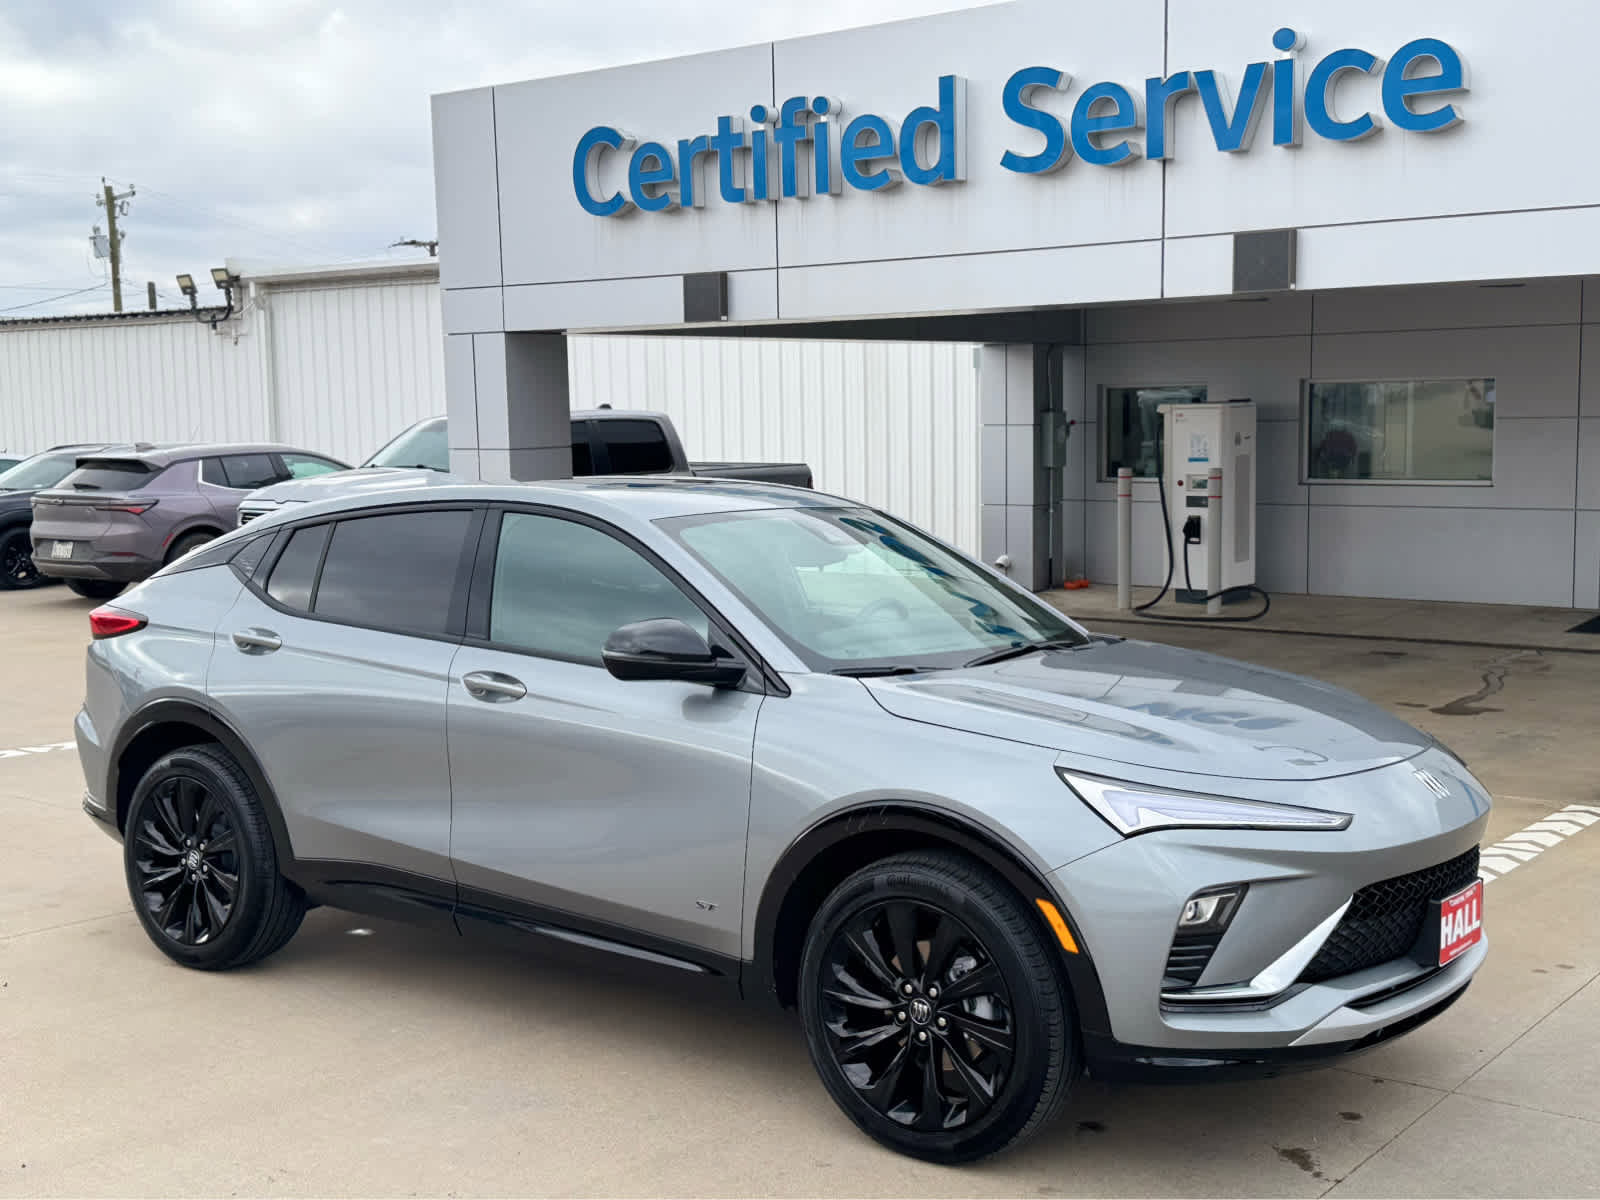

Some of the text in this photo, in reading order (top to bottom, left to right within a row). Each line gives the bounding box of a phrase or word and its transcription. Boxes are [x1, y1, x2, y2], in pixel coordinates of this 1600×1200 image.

[573, 27, 1466, 217] Certified Service
[1440, 898, 1481, 950] HALL
